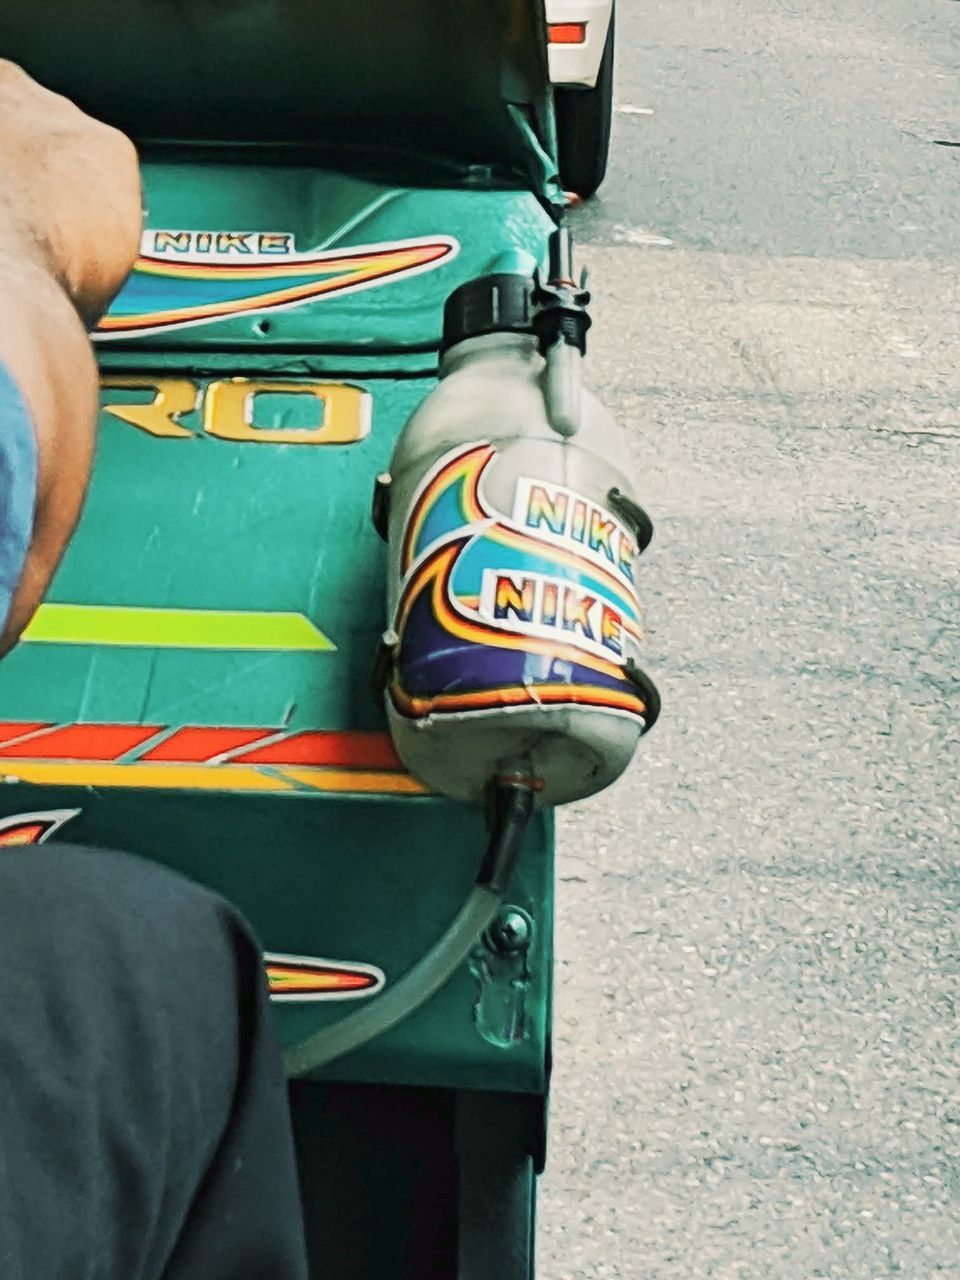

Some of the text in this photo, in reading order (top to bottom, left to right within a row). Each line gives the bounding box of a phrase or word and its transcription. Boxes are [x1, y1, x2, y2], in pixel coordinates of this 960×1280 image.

[154, 232, 291, 255] NIKE
[525, 485, 634, 584] NIKE
[493, 575, 622, 656] NIKE
